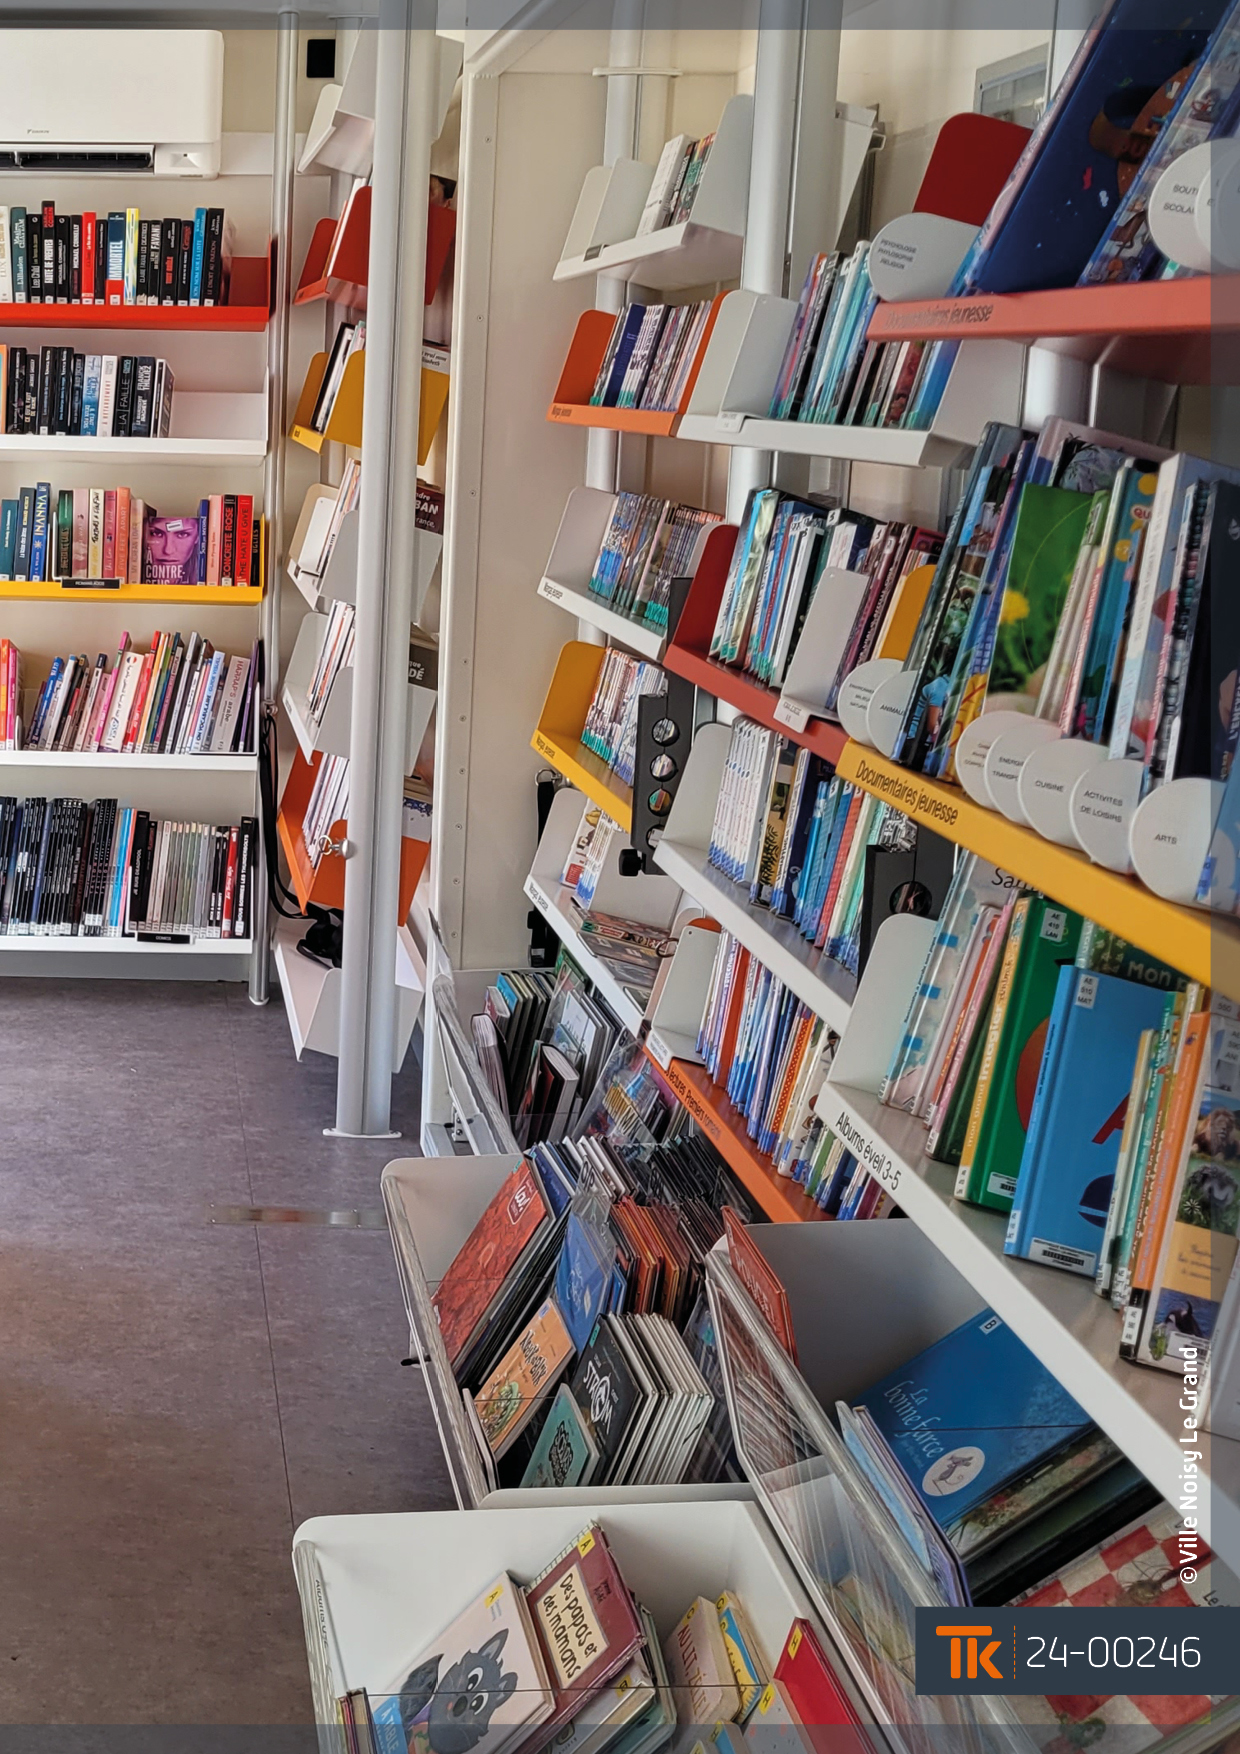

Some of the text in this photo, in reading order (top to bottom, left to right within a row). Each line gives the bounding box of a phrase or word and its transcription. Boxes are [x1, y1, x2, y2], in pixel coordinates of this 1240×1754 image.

[1163, 202, 1195, 214] SCOLAI
[109, 240, 123, 280] IMMORTEL
[31, 266, 40, 288] Lee Child
[137, 366, 145, 391] FRANCK
[143, 365, 151, 390] THILLIEZ
[119, 378, 130, 426] LA FAILLE
[35, 494, 47, 536] INANNA
[223, 507, 233, 577] CONCRETE ROSE
[145, 565, 185, 579] CONTRE-
[199, 695, 212, 730] VOCABULAIRE
[855, 760, 959, 825] Documentaires jeunesse
[1035, 780, 1065, 792] CUISINE
[1083, 790, 1123, 807] ACTIVITES
[1080, 805, 1122, 823] DE LOISIRS
[1154, 834, 1177, 845] ARTS
[240, 834, 249, 873] THUNDERBOLTS
[1045, 930, 1058, 939] LAN
[1048, 921, 1060, 929] 410
[1084, 977, 1093, 985] AE
[1127, 960, 1171, 986] Mon
[1077, 996, 1093, 1005] MAT
[668, 1067, 685, 1094] lectures
[835, 1111, 902, 1191] Albums éveil 3-5
[983, 1318, 997, 1332] B
[910, 1388, 929, 1405] La
[884, 1380, 945, 1458] bonne farce
[580, 1539, 592, 1552] A
[489, 1591, 498, 1601] A
[560, 1572, 598, 1658] Des papas et
[543, 1593, 581, 1679] des mamans
[382, 1716, 399, 1754] TABLE
